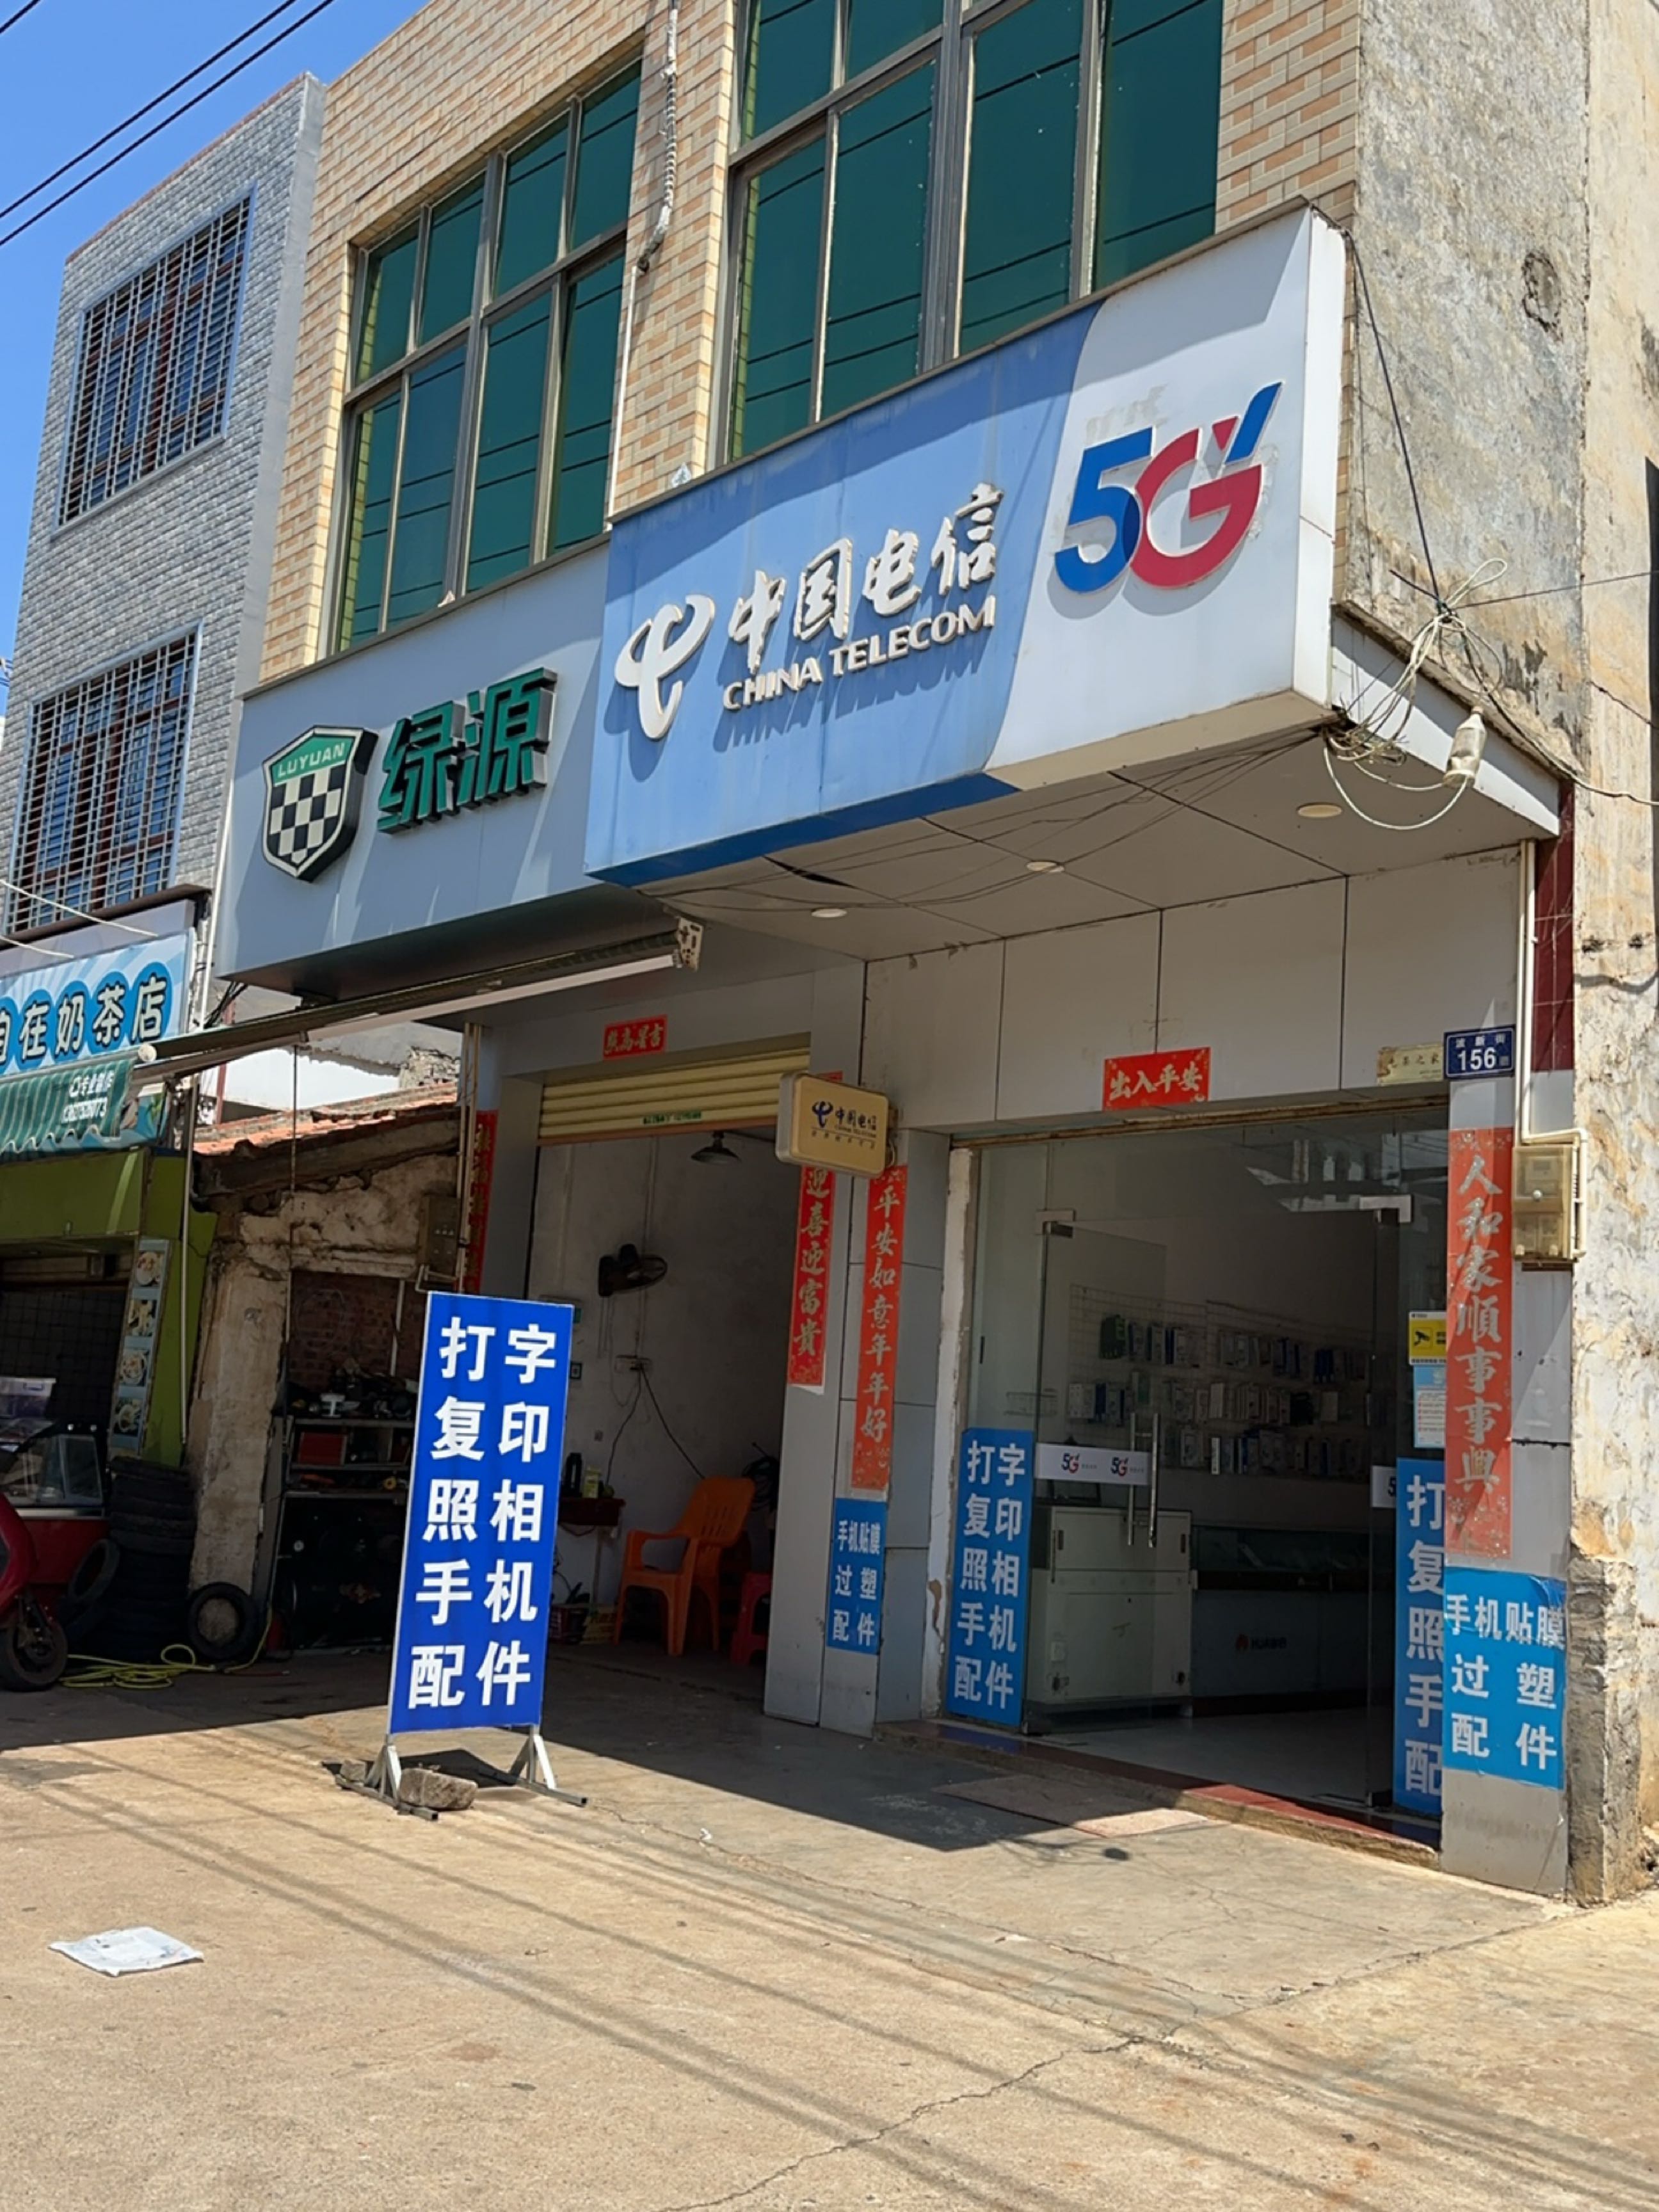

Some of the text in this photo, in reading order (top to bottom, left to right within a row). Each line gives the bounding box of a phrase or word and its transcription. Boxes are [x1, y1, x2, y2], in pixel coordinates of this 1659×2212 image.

[1054, 403, 1274, 591] 5G
[728, 482, 1003, 675] 中国电信
[723, 595, 996, 711] CHINA TELECOM
[277, 742, 345, 778] LUYUAN
[376, 667, 557, 834] 绿源
[1109, 1061, 1203, 1101] 出入平安
[1457, 1046, 1496, 1071] 156
[860, 1189, 901, 1443] 平安如意年年好
[439, 1317, 557, 1384] 打字
[430, 1395, 549, 1462] 复印
[967, 1439, 1025, 1487] 打字
[1061, 1452, 1080, 1473] 5G
[1110, 1457, 1128, 1477] 5G
[1388, 1476, 1397, 1496] 5
[422, 1479, 544, 1542] 照相
[837, 1519, 881, 1555] 手机贴膜
[963, 1493, 1022, 1541] 复印
[415, 1559, 538, 1626] 手机
[835, 1565, 878, 1600] 过塑
[960, 1546, 1020, 1598] 照相
[832, 1605, 875, 1647] 配件
[957, 1602, 1016, 1652] 手机
[1444, 1594, 1566, 1649] 手机贴膜
[408, 1640, 531, 1709] 配件
[954, 1655, 1014, 1710] 配件
[1451, 1653, 1557, 1710] 过塑
[1451, 1712, 1558, 1771] 配件
